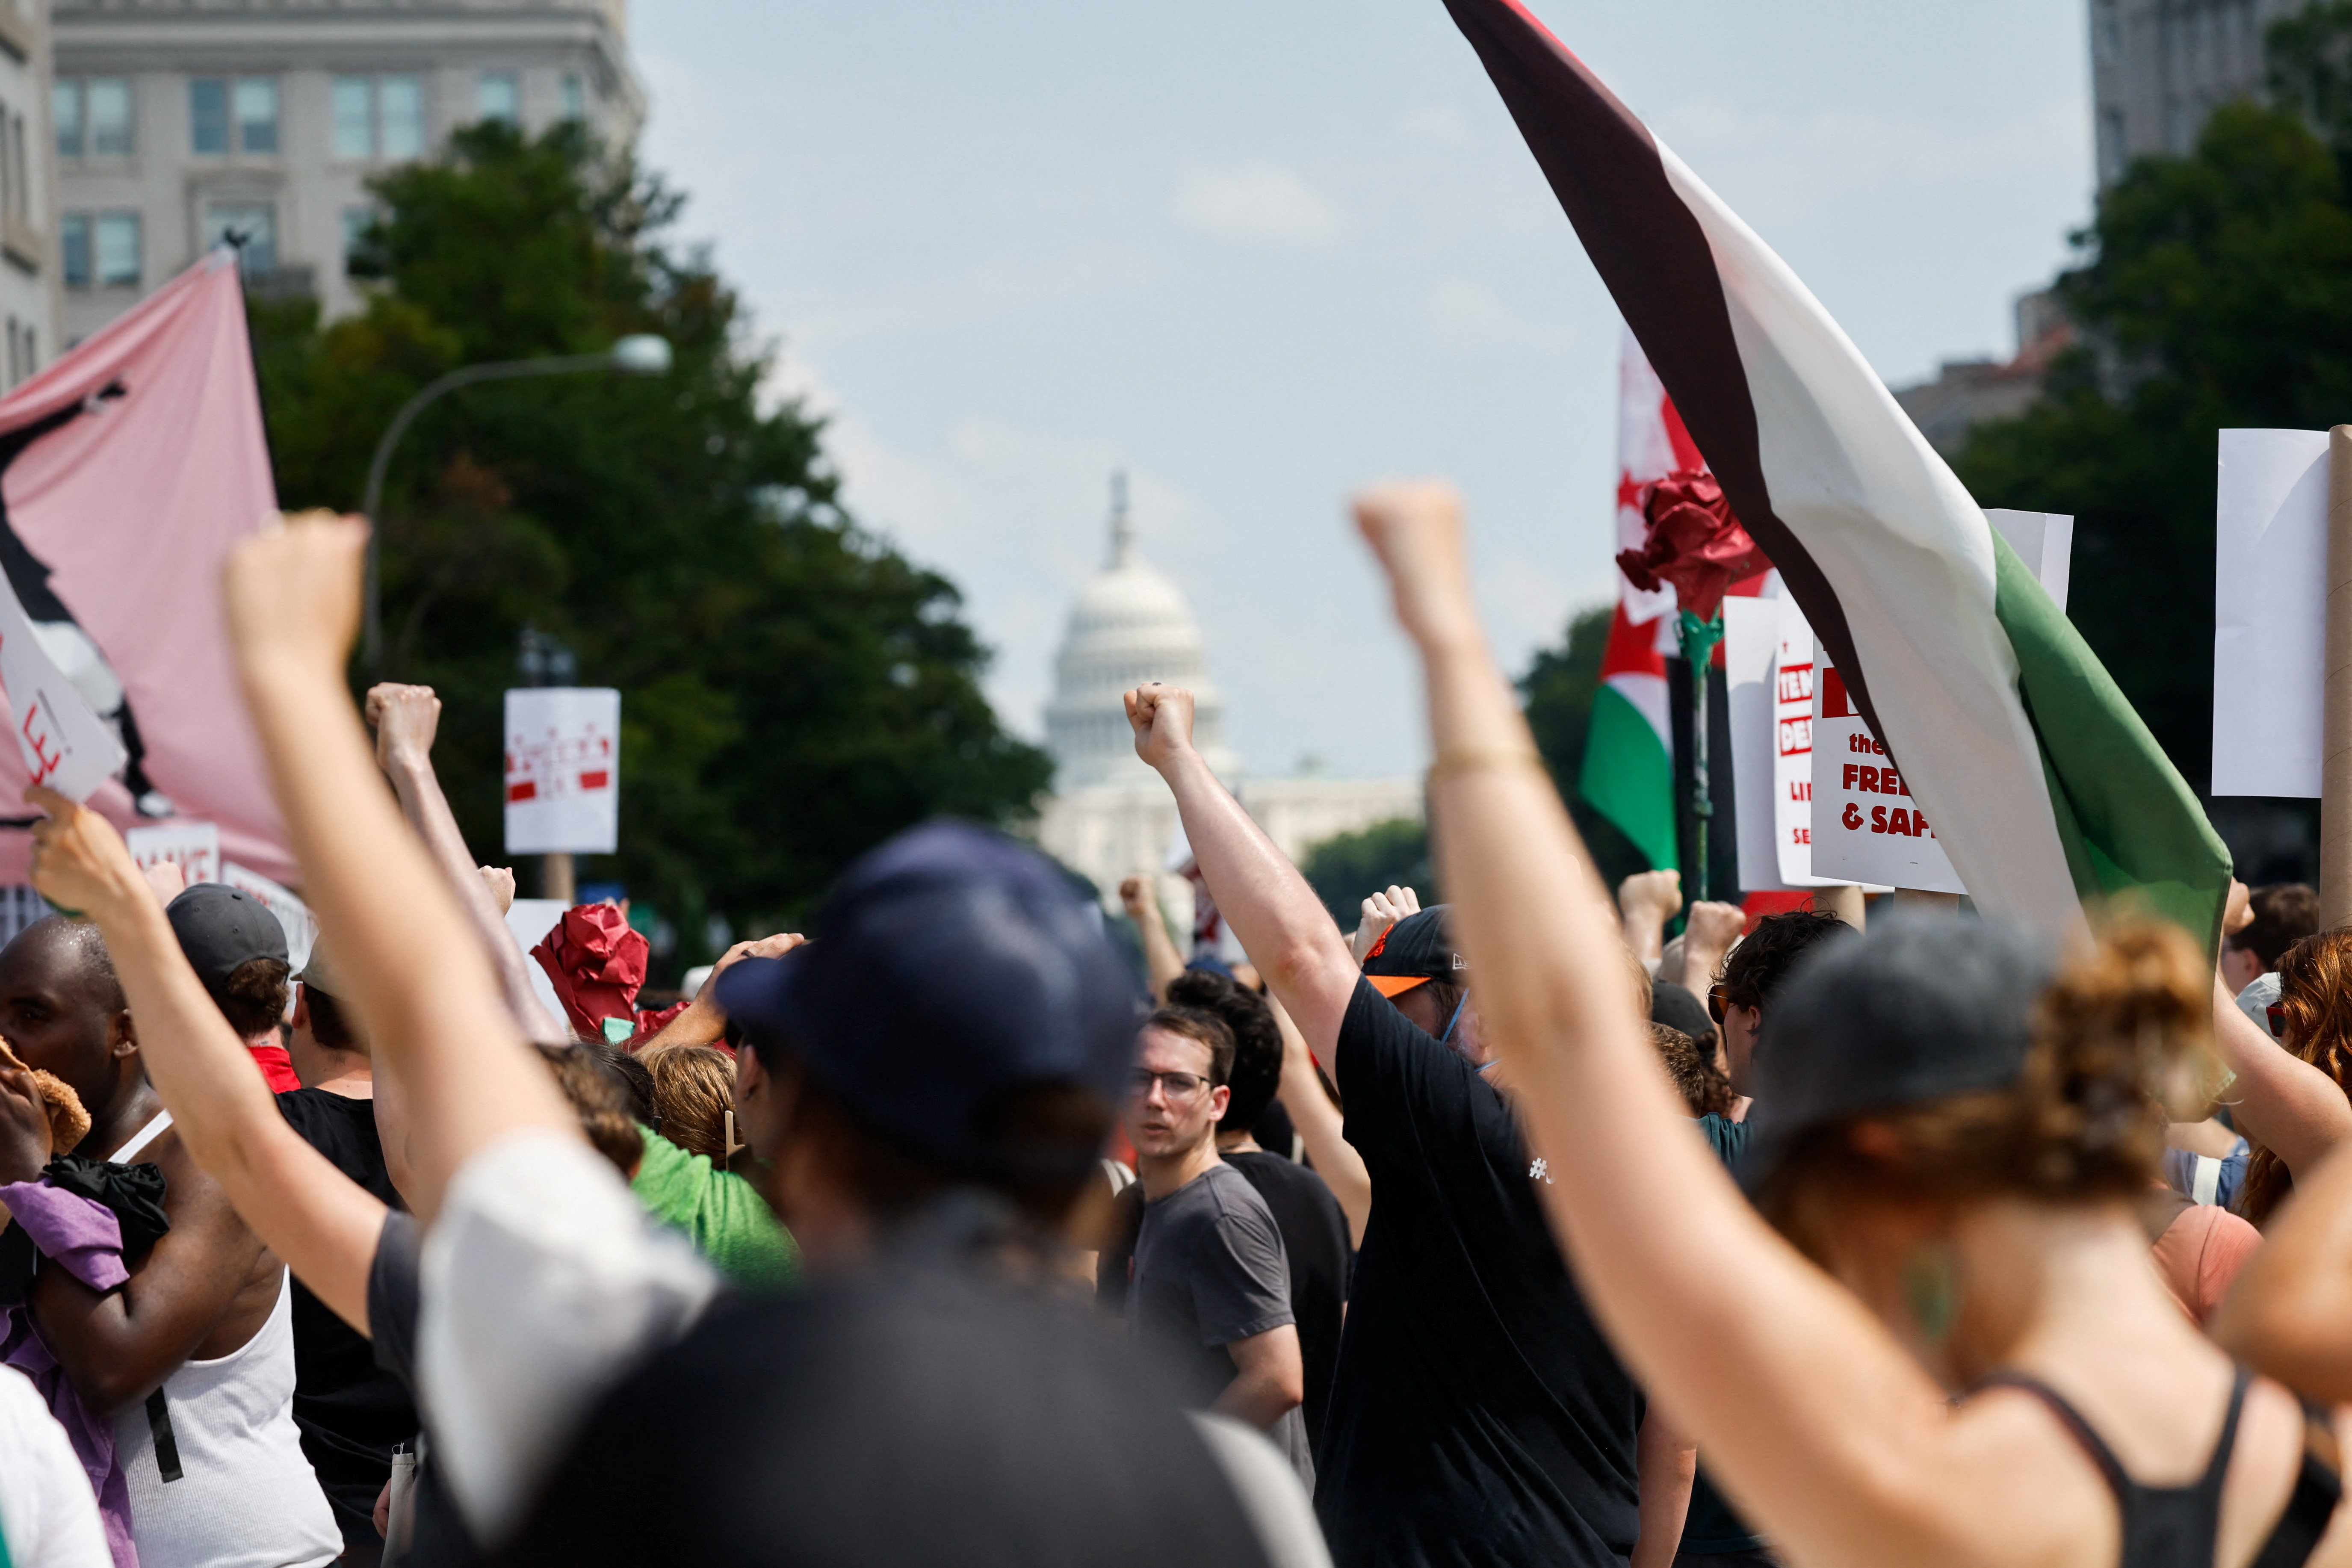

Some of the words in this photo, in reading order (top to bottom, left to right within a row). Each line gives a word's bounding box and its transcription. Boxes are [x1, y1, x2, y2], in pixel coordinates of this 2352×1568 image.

[1780, 718, 1813, 753] DE
[1842, 802, 1864, 830] &
[1871, 805, 1937, 839] SAF
